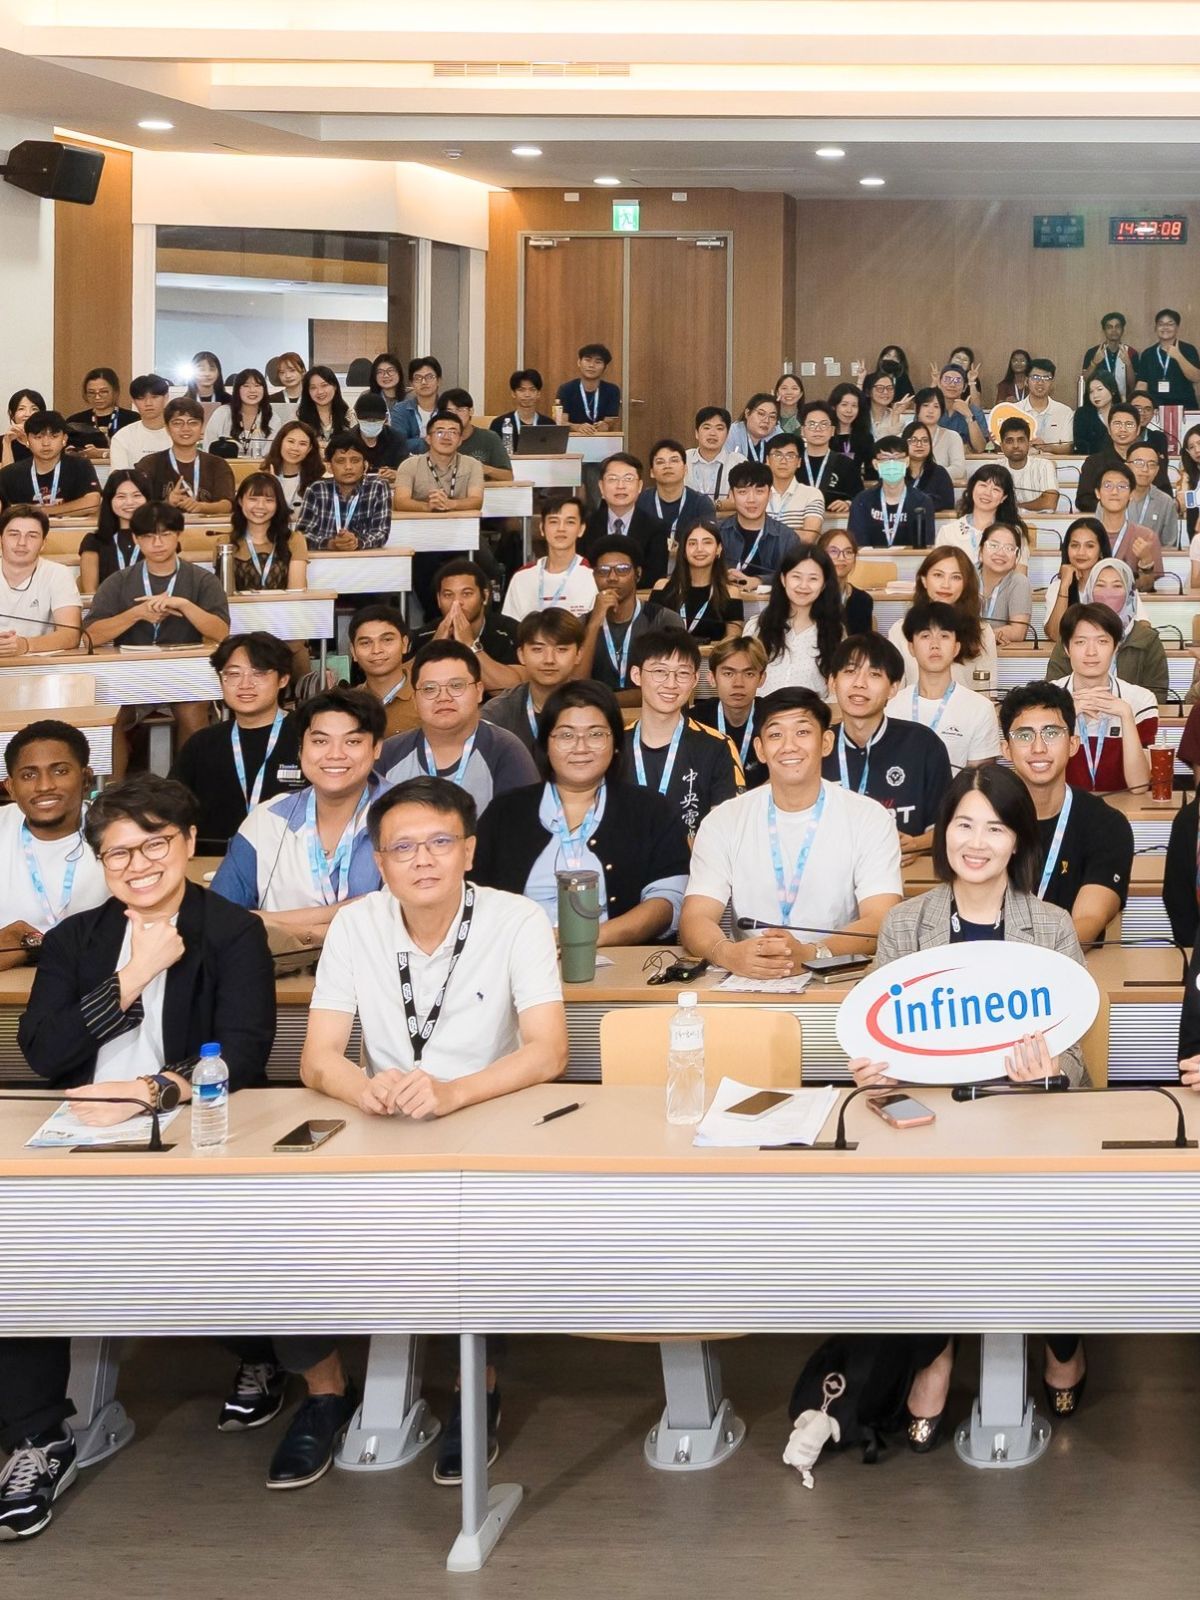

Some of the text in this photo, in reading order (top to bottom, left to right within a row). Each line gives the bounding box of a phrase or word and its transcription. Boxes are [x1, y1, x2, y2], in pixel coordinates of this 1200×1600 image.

[402, 982, 413, 1004] GSA
[890, 983, 1052, 1035] infineon
[408, 1016, 418, 1038] GSA
